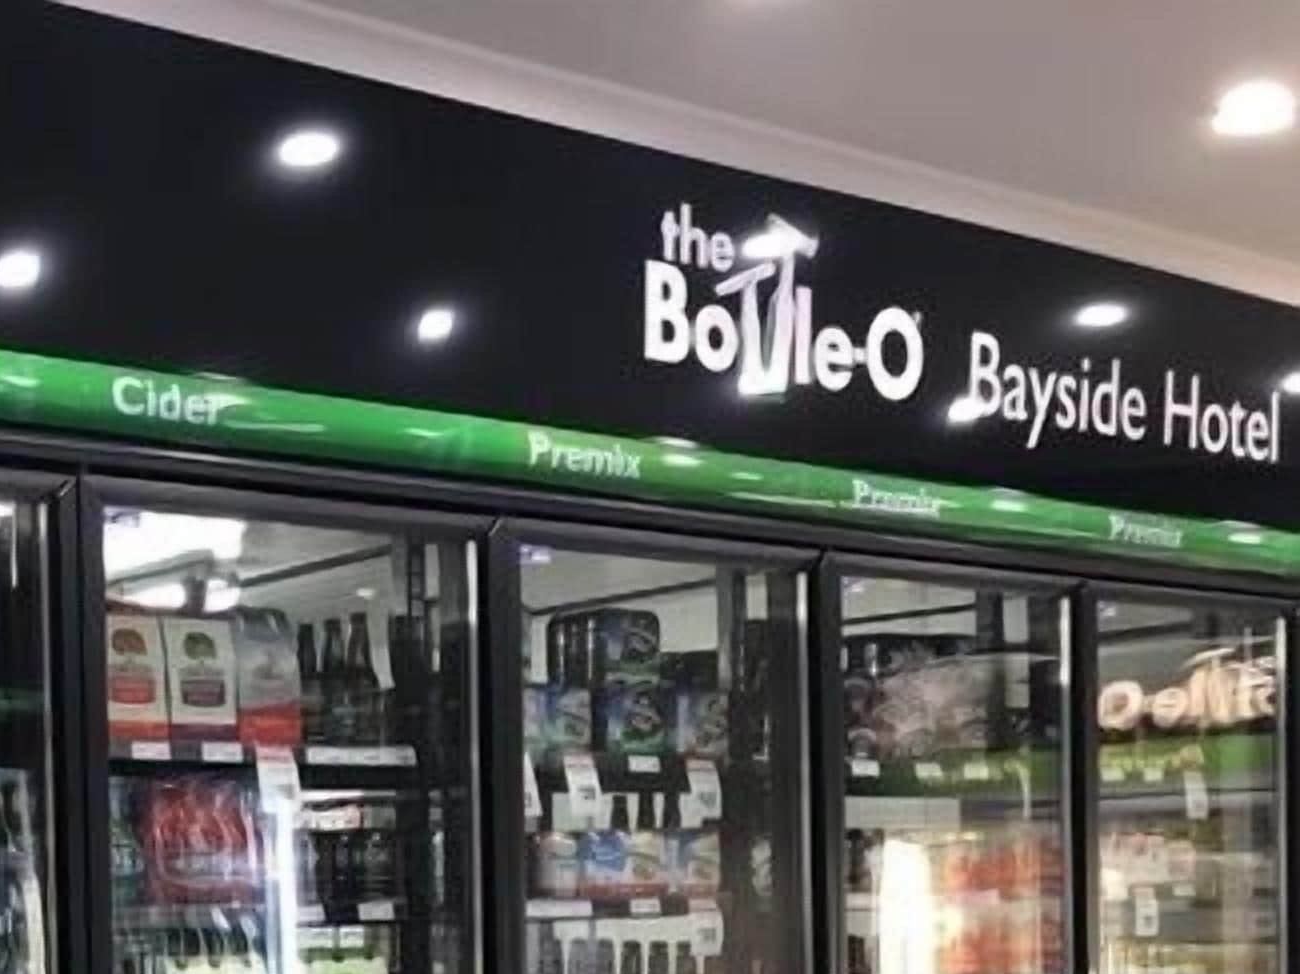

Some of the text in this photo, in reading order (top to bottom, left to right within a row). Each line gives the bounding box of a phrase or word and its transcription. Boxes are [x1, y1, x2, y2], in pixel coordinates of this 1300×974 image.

[660, 203, 734, 273] the
[111, 375, 224, 427] Cider
[971, 328, 1148, 450] Bayside
[1163, 369, 1280, 465] Hotel
[527, 429, 642, 480] Premix
